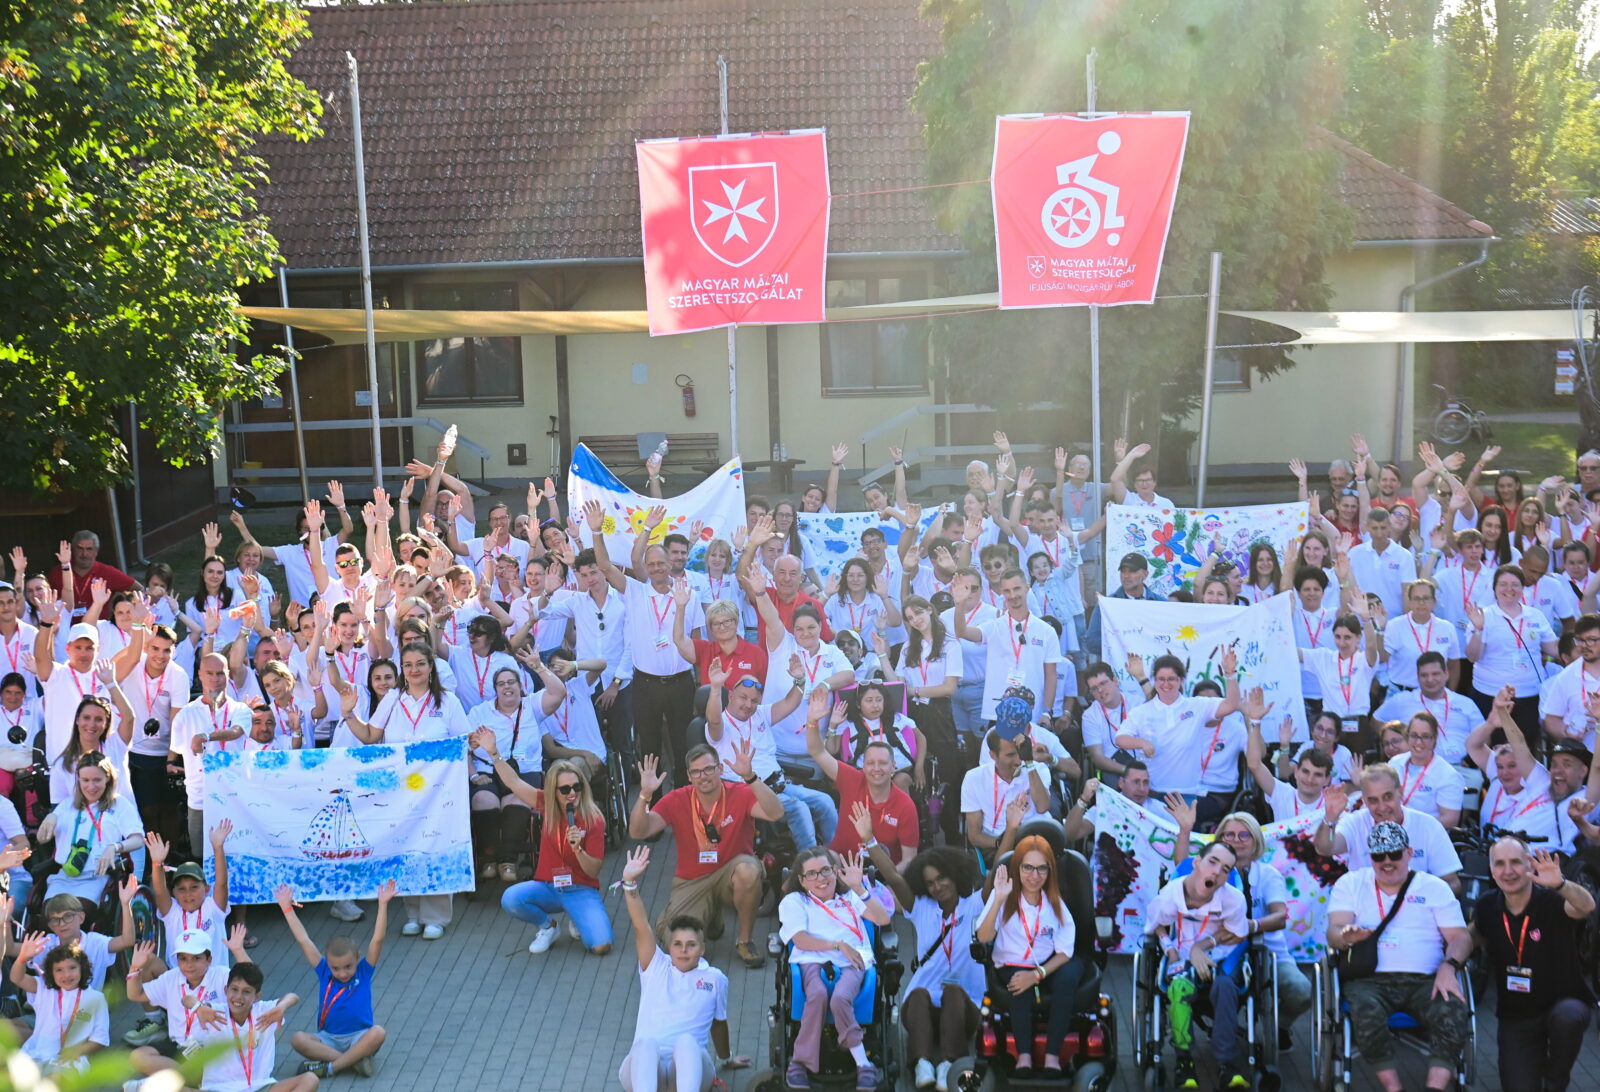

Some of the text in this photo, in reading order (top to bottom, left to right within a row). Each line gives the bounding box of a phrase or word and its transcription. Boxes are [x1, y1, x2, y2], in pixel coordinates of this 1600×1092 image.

[1050, 256, 1128, 268] MAGYAR MLTAI
[681, 272, 789, 292] MAGYAR MÁLTAI
[668, 285, 804, 309] SZERETETSZOGÁLAT
